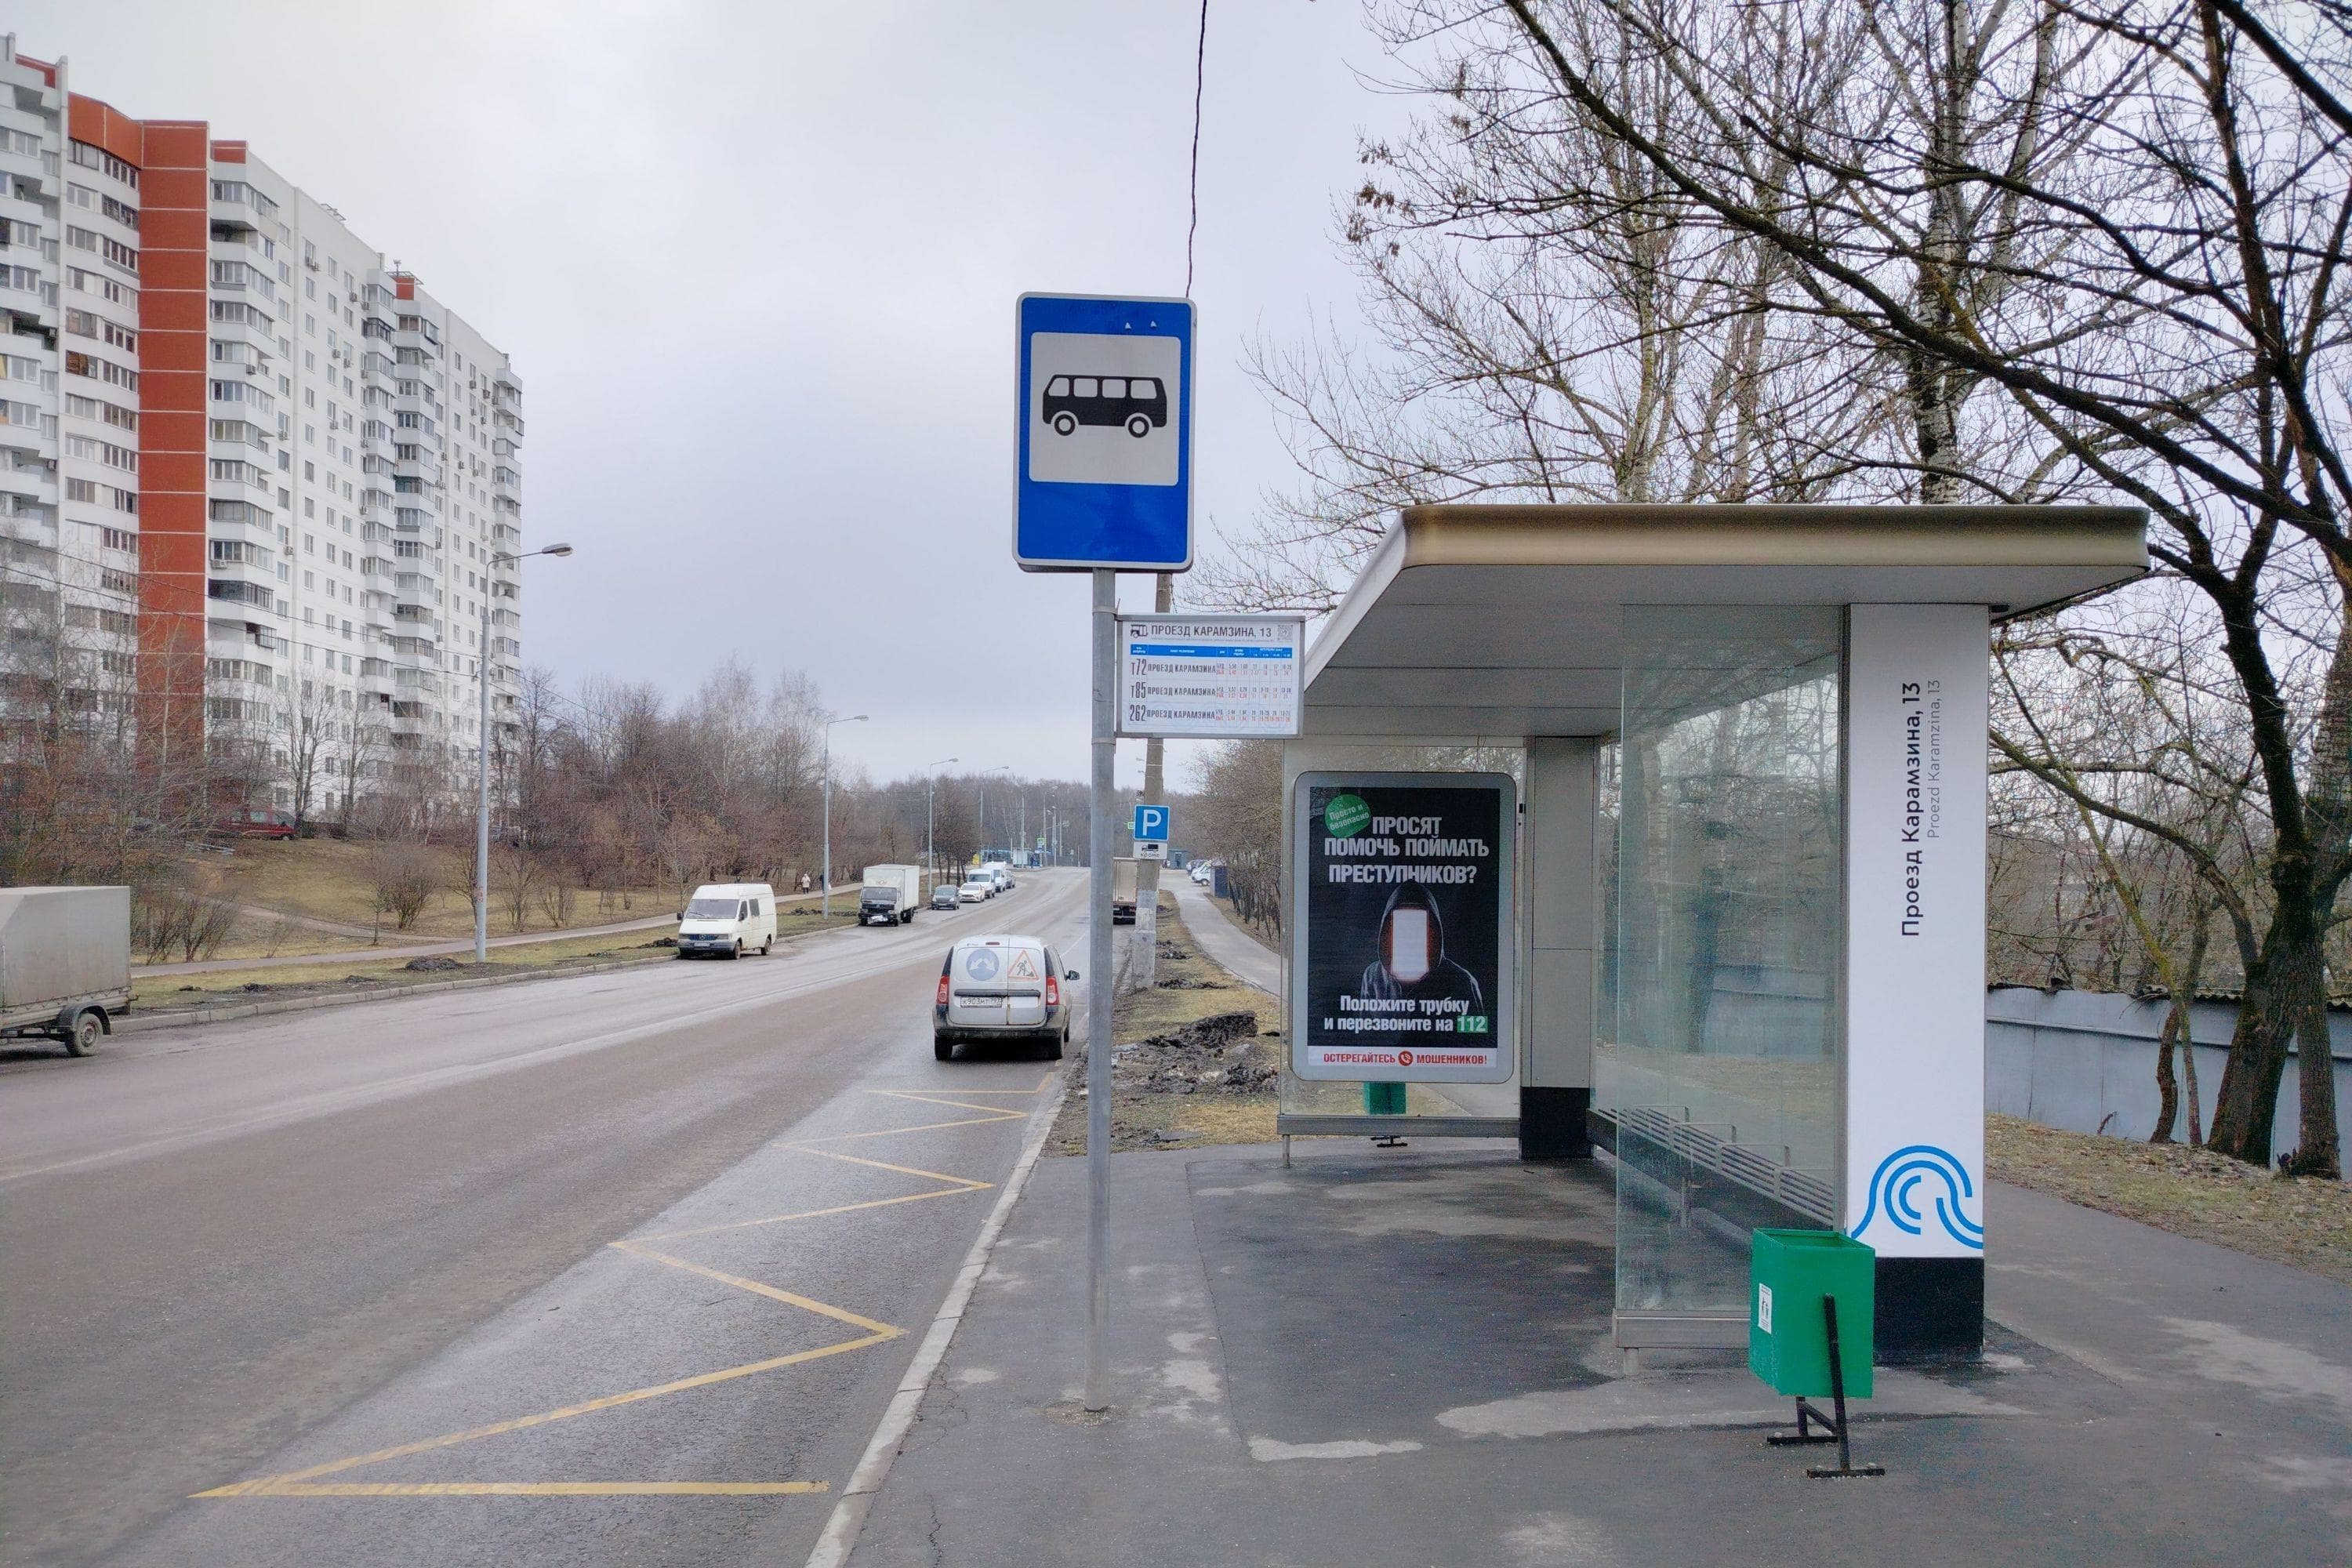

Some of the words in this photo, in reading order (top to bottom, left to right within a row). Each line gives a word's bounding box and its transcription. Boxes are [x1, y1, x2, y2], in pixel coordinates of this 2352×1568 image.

[1151, 625, 1191, 637] ПРОЕЗД
[1193, 626, 1257, 638] КАРАМЗИНА,
[1261, 627, 1272, 637] 13
[1148, 663, 1174, 673] ПРОЕЗД
[1175, 664, 1216, 673] КАРАМЗИНА
[1147, 687, 1173, 696] ПРОЕЗД
[1174, 687, 1215, 696] КАРАМЗИНА
[1902, 682, 1921, 704] 13
[1928, 680, 1940, 695] 13
[1130, 705, 1145, 722] 262
[1147, 710, 1172, 719] ПРОЕЗД
[1174, 710, 1215, 720] КАРАМЗИНА
[1927, 698, 1942, 782] Karamzina,
[1901, 710, 1924, 842] Карамзина,
[1142, 809, 1162, 836] P
[1330, 807, 1356, 820] Просто
[1330, 812, 1370, 830] безопасно
[1927, 787, 1940, 839] Proezd
[1372, 816, 1443, 835] ПРОСЯТ
[1324, 837, 1400, 857] ПОМОЧЬ
[1406, 834, 1490, 858] ПОЙМАТЬ
[1329, 865, 1477, 884] ПРЕСТУПНИКОВ?
[1901, 850, 1924, 936] Проезд
[1340, 995, 1416, 1013] Положите
[1420, 996, 1469, 1015] трубку
[1324, 1019, 1334, 1029] и
[1338, 1019, 1432, 1034] перезвоните
[1436, 1021, 1454, 1032] на
[1457, 1016, 1486, 1032] 112
[1323, 1052, 1396, 1064] ОСТЕРЕГАЙТЕСЬ
[1417, 1054, 1487, 1065] МОШЕННИКОВ!
